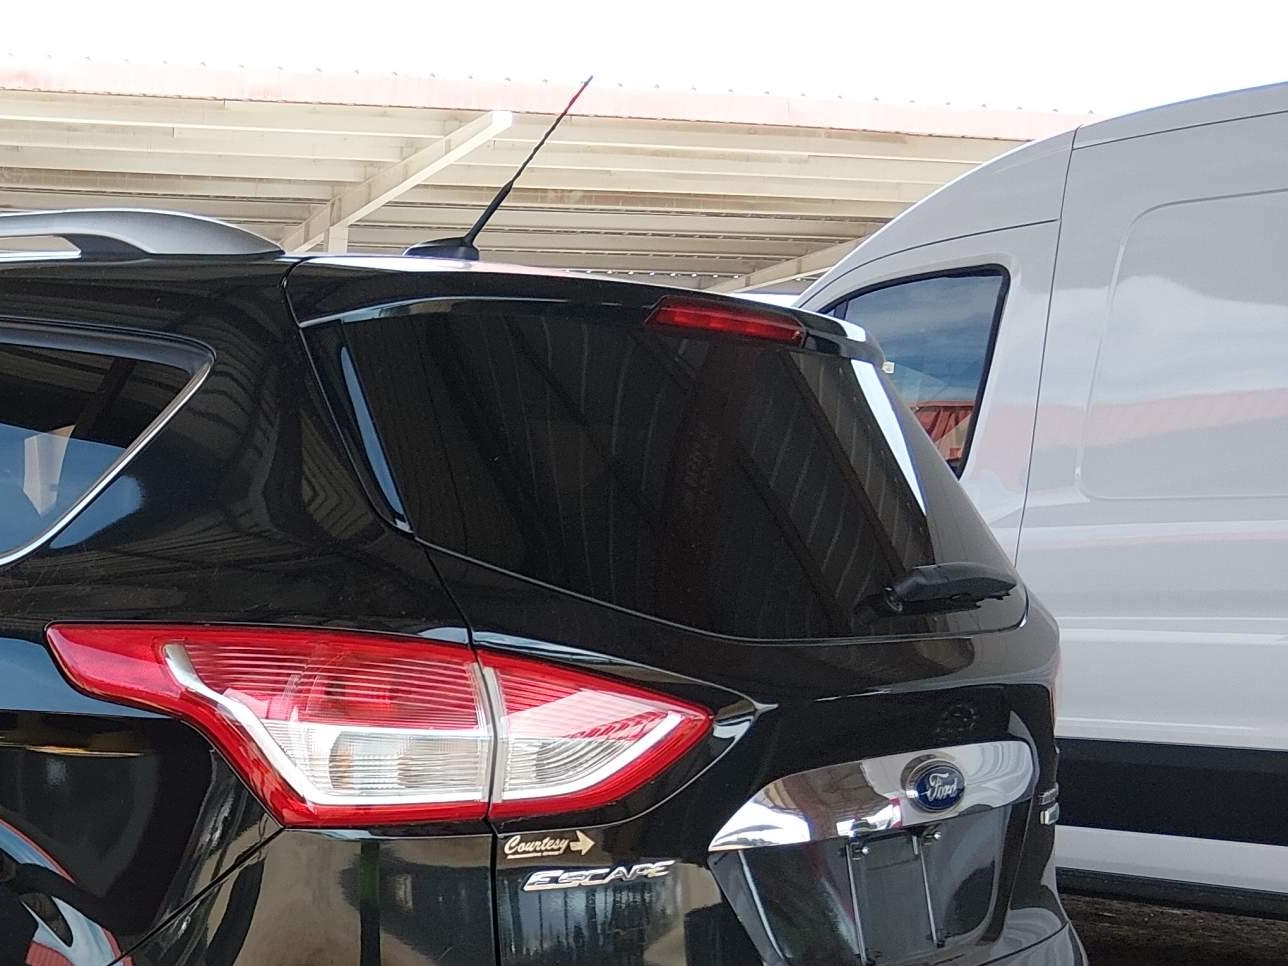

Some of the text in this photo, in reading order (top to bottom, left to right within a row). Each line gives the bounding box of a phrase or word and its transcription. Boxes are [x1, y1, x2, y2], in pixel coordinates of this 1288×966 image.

[923, 772, 958, 801] Ford
[504, 835, 569, 854] Courtesy
[523, 859, 676, 892] ESCAPE
